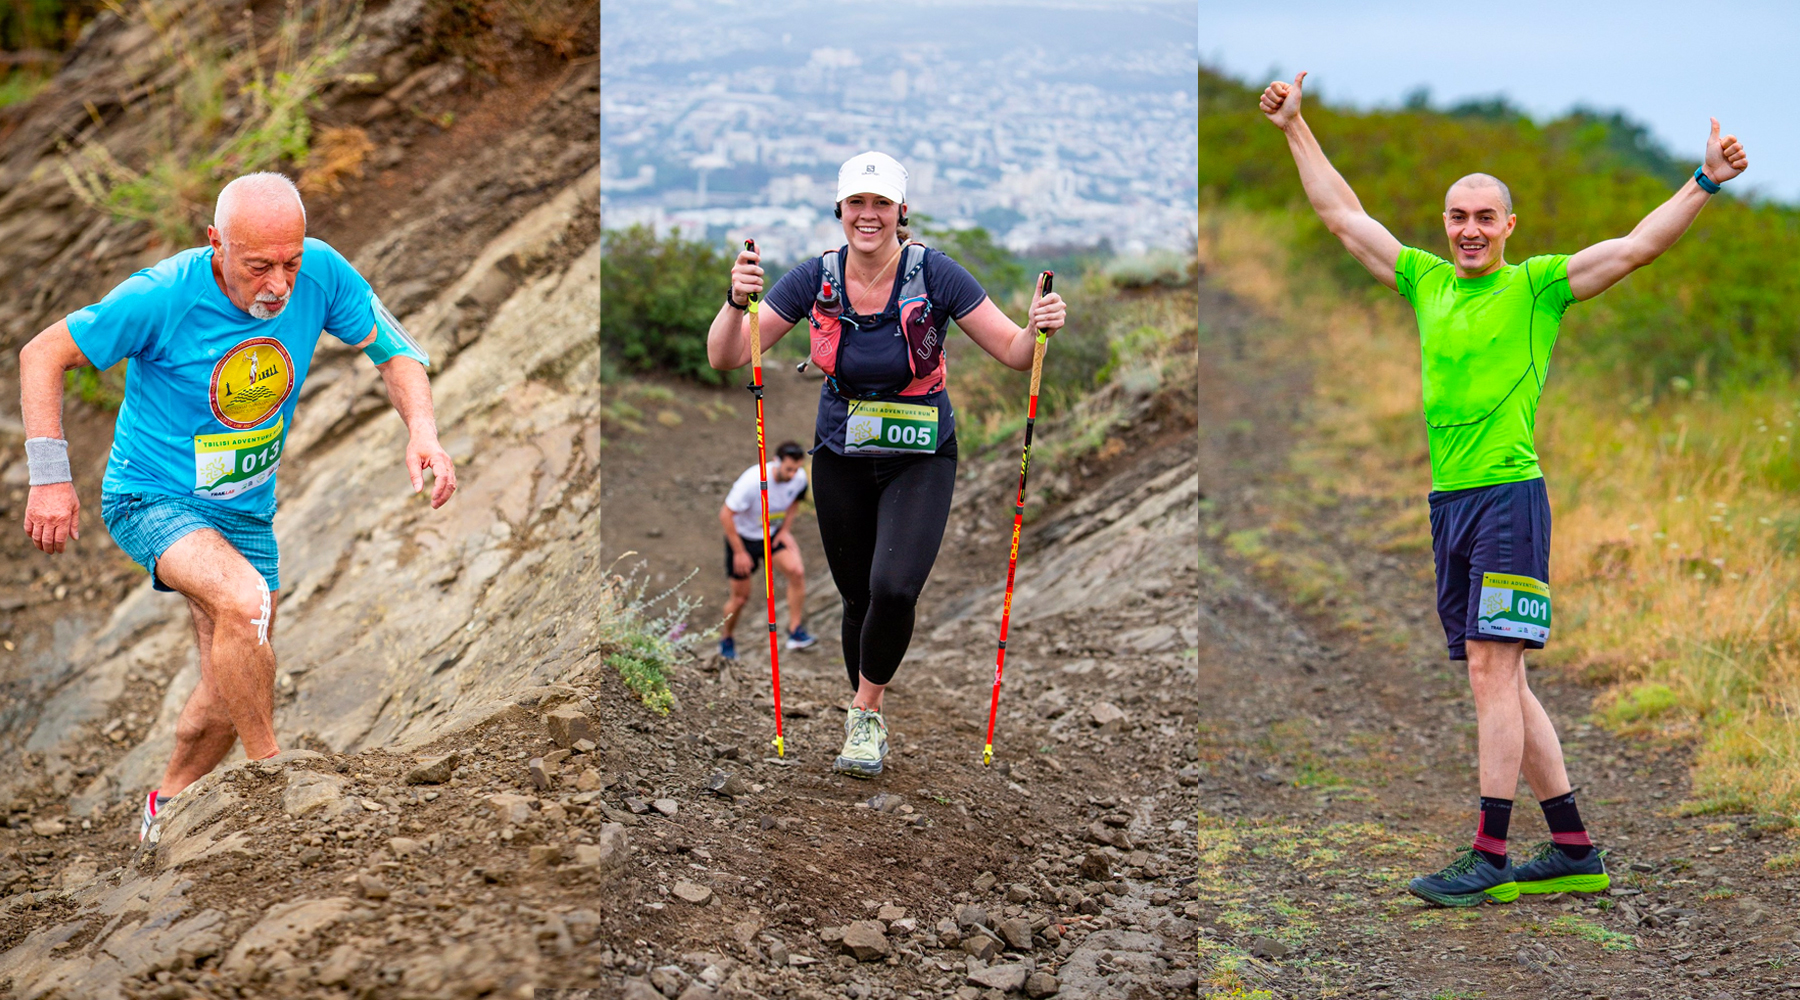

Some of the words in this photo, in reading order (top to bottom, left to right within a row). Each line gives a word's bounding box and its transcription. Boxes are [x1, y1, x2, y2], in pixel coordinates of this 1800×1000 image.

[232, 434, 272, 445] ADVENTURE
[887, 424, 931, 446] 005
[242, 440, 280, 473] 013
[1517, 597, 1546, 620] 001
